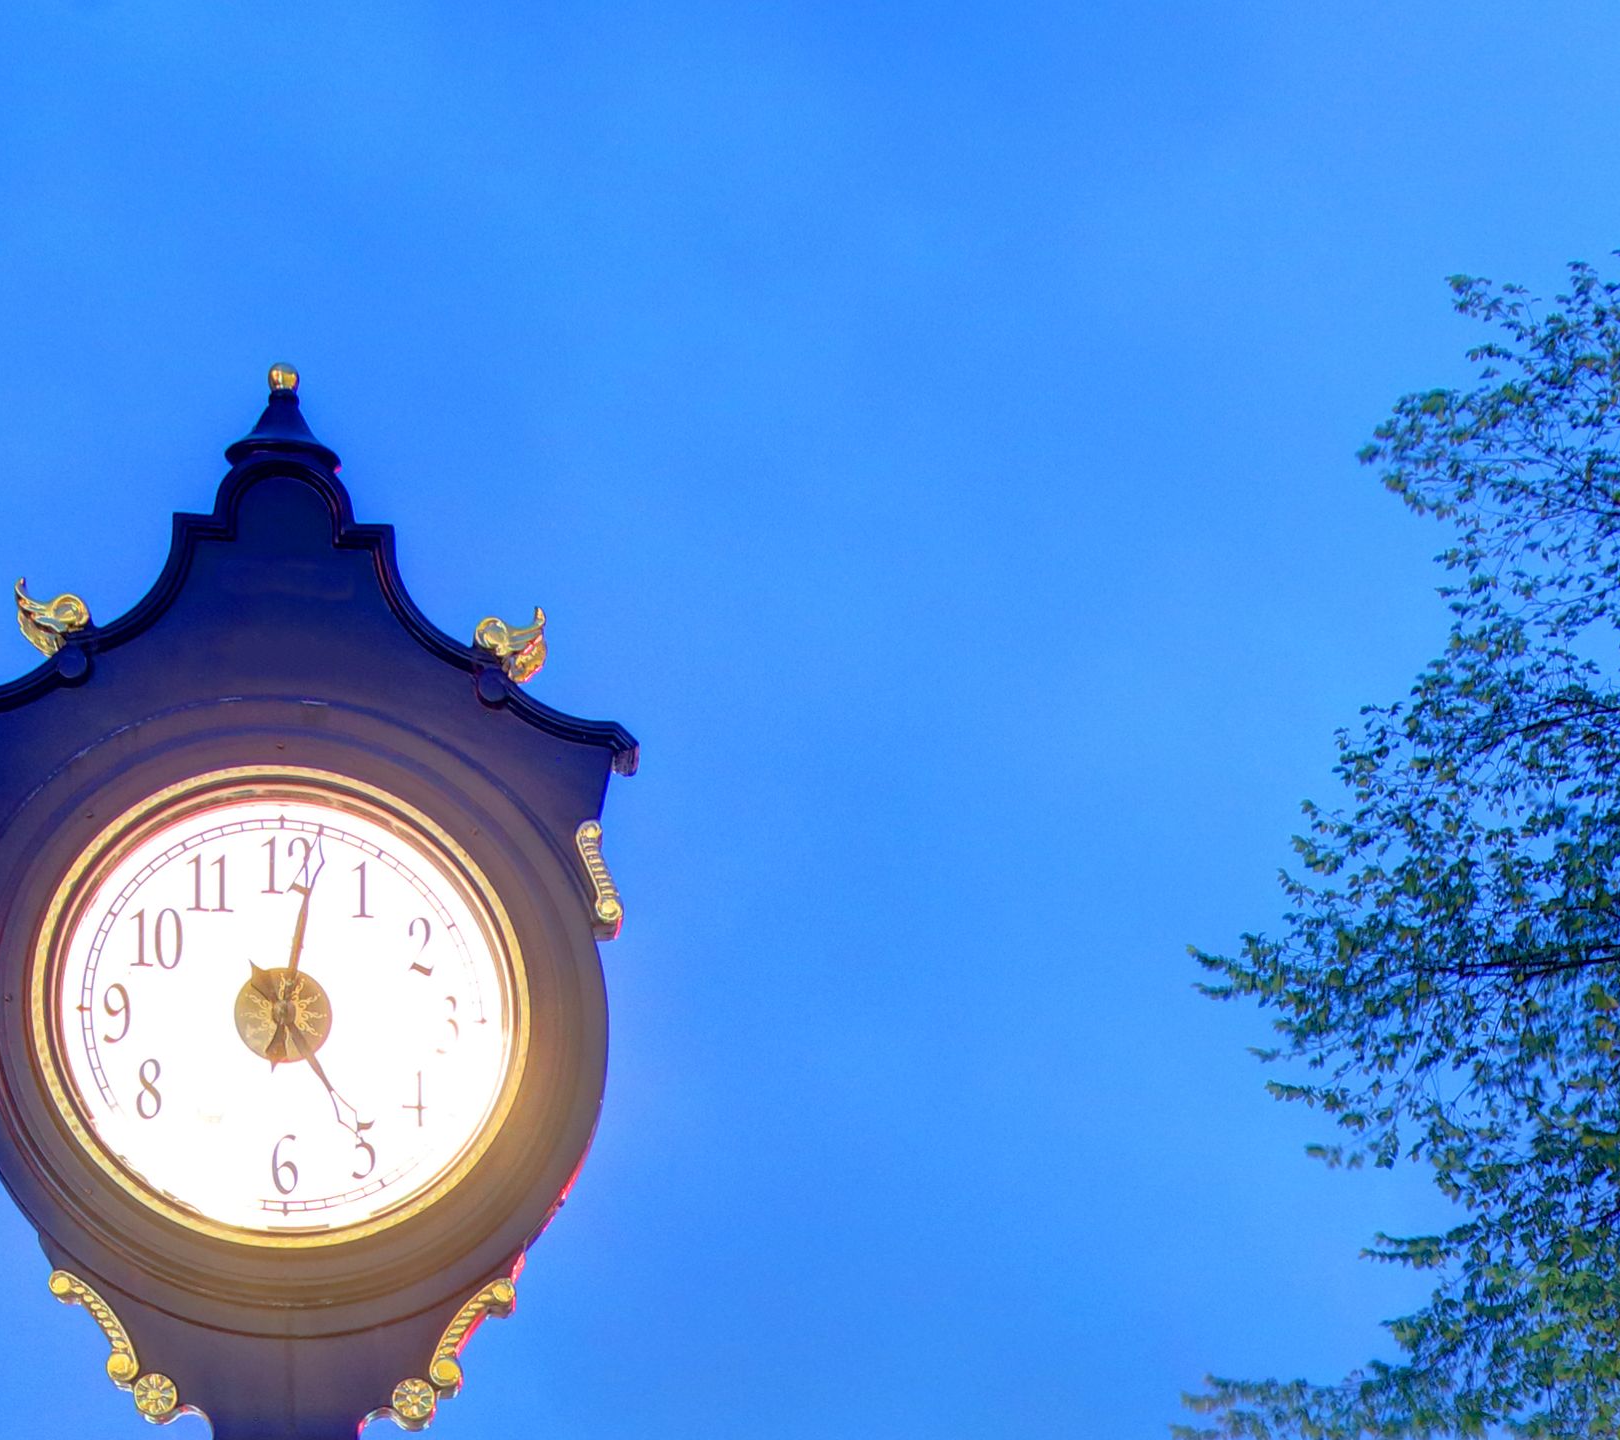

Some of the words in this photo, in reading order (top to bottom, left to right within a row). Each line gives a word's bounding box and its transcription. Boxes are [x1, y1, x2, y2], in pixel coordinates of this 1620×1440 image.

[186, 853, 234, 914] 11
[260, 835, 312, 895] 12
[351, 860, 375, 919] 1
[129, 907, 183, 970] 10
[408, 916, 434, 977] 2
[102, 982, 131, 1044] 9
[434, 994, 460, 1055] 3
[135, 1057, 163, 1121] 8
[402, 1069, 428, 1127] 4
[270, 1133, 299, 1196] 6
[351, 1119, 377, 1180] 5
